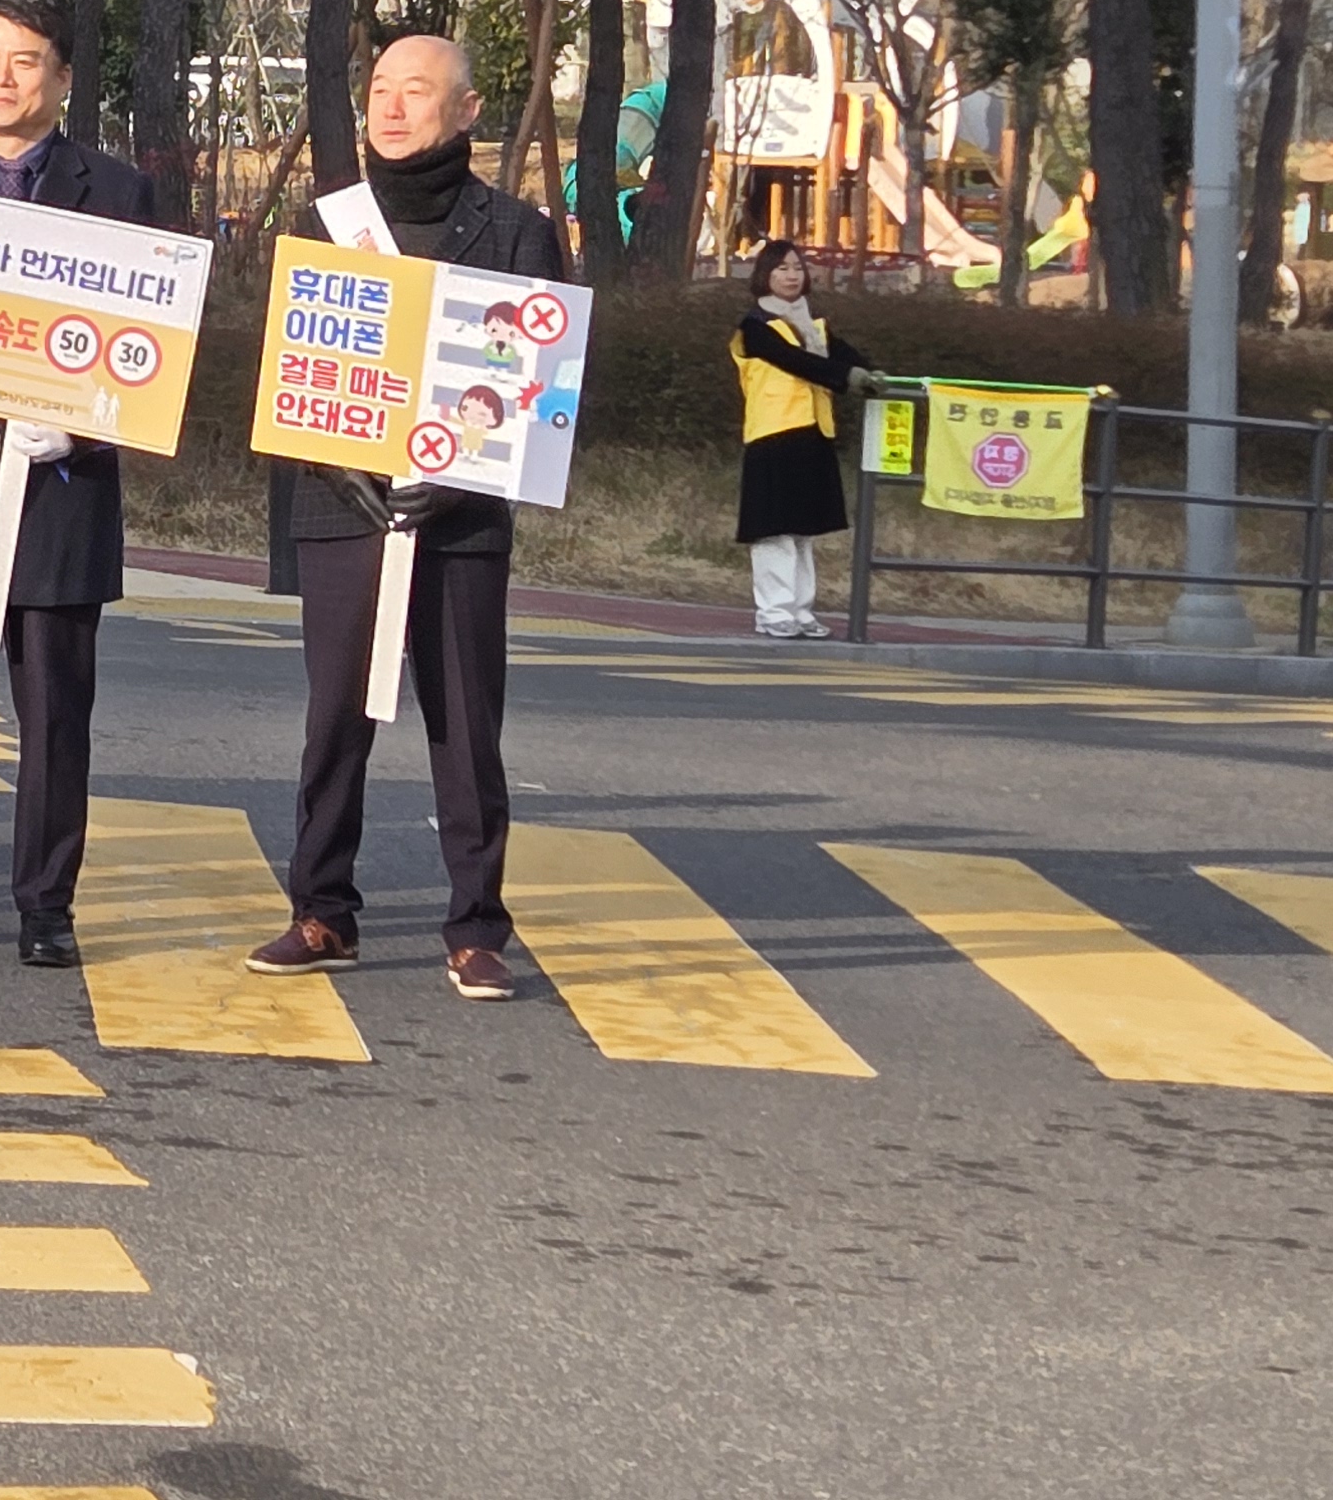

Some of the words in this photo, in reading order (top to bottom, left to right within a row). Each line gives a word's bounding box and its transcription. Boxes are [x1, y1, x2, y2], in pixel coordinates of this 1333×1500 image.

[20, 248, 177, 306] 먼저입니다!
[289, 268, 390, 315] 휴대폰
[59, 329, 90, 355] 50
[118, 341, 149, 368] 30
[285, 309, 384, 356] 이어폰
[280, 353, 340, 391] 걸을
[349, 365, 410, 404] 때는
[275, 393, 386, 440] 안돼요!
